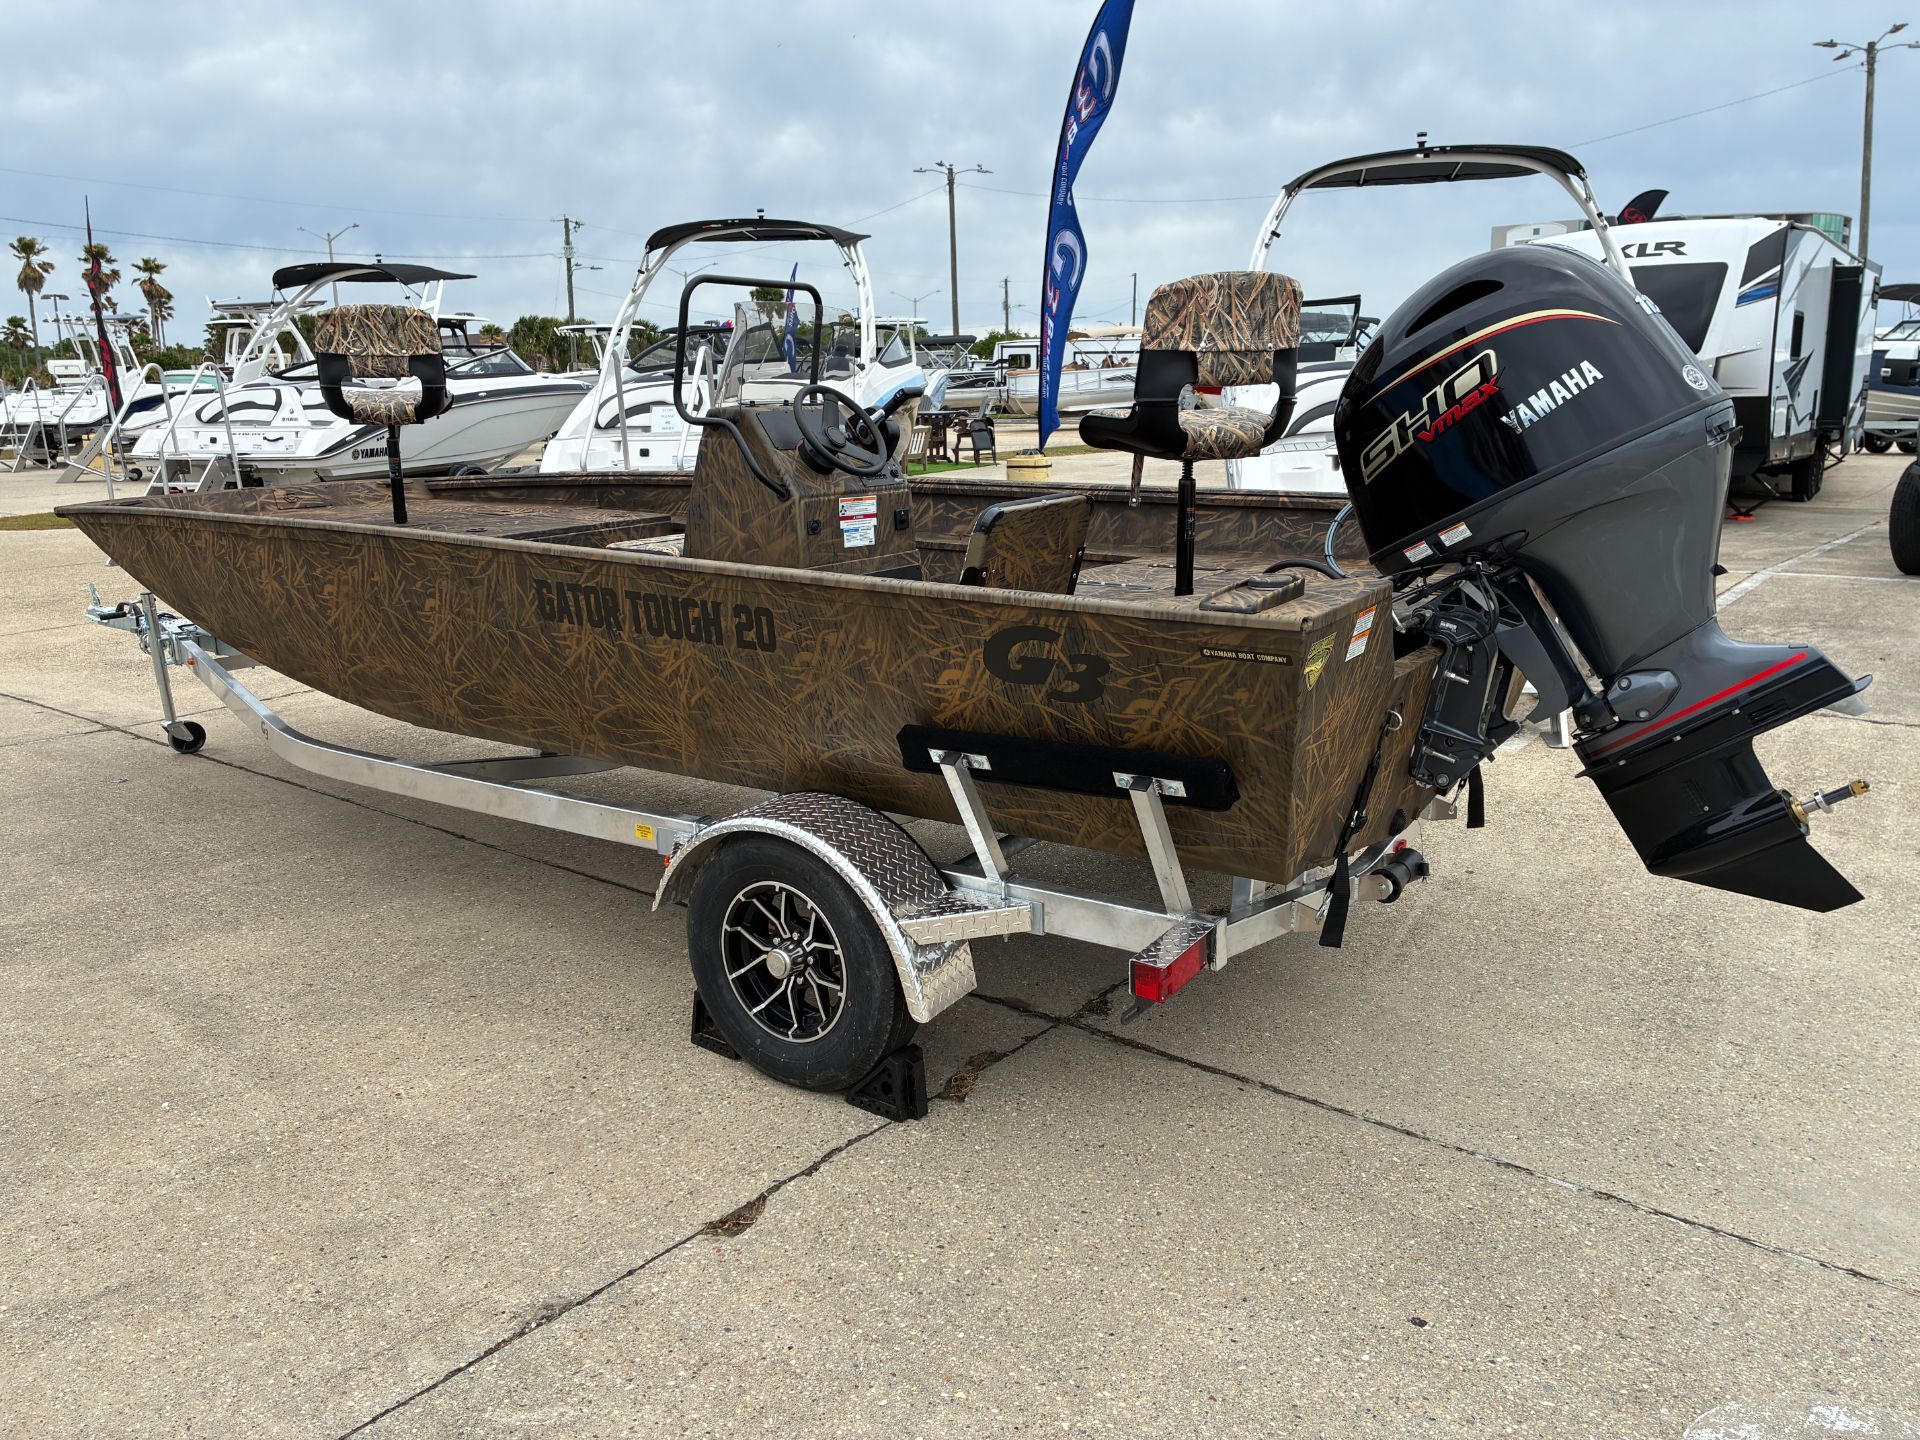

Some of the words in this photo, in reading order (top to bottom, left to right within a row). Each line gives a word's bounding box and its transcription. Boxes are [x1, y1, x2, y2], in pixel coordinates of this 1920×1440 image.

[1360, 349, 1498, 485] SHO
[1500, 359, 1604, 436] YAMAHA
[534, 579, 623, 632] GATOR
[625, 590, 724, 646] TOUGH
[732, 603, 777, 653] 20
[983, 625, 1111, 703] G3
[1210, 650, 1237, 659] YAMAHA
[1238, 652, 1255, 660] BOAT
[1256, 654, 1287, 663] COMPANY
